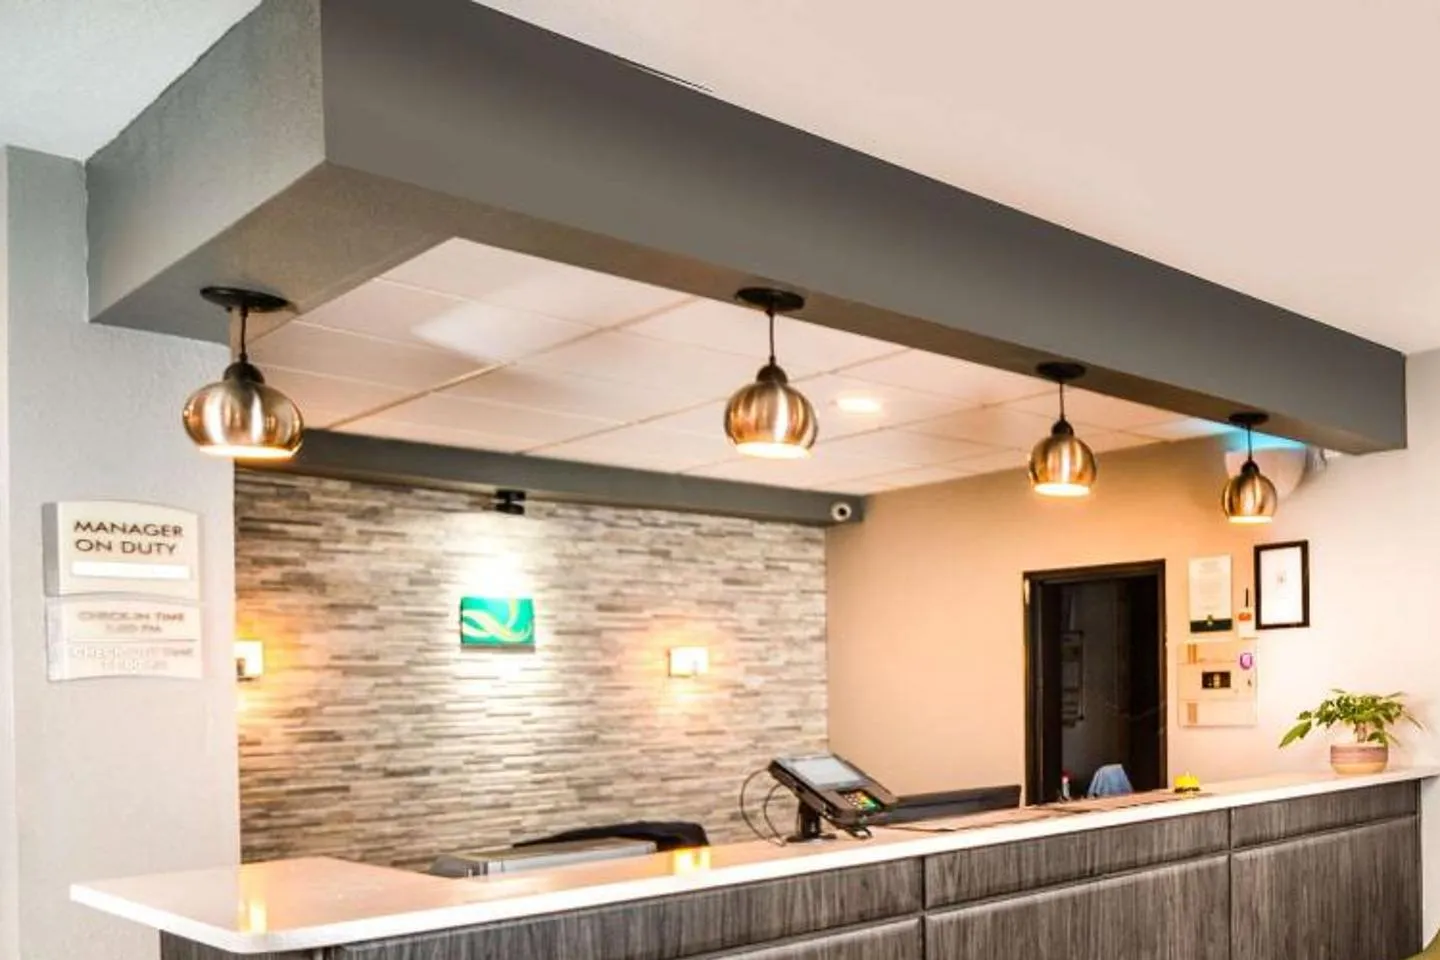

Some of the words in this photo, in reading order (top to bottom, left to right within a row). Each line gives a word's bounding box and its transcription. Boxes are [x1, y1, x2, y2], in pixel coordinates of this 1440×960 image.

[74, 521, 184, 537] MANAGER
[75, 539, 112, 552] ON
[121, 541, 176, 555] DUTY
